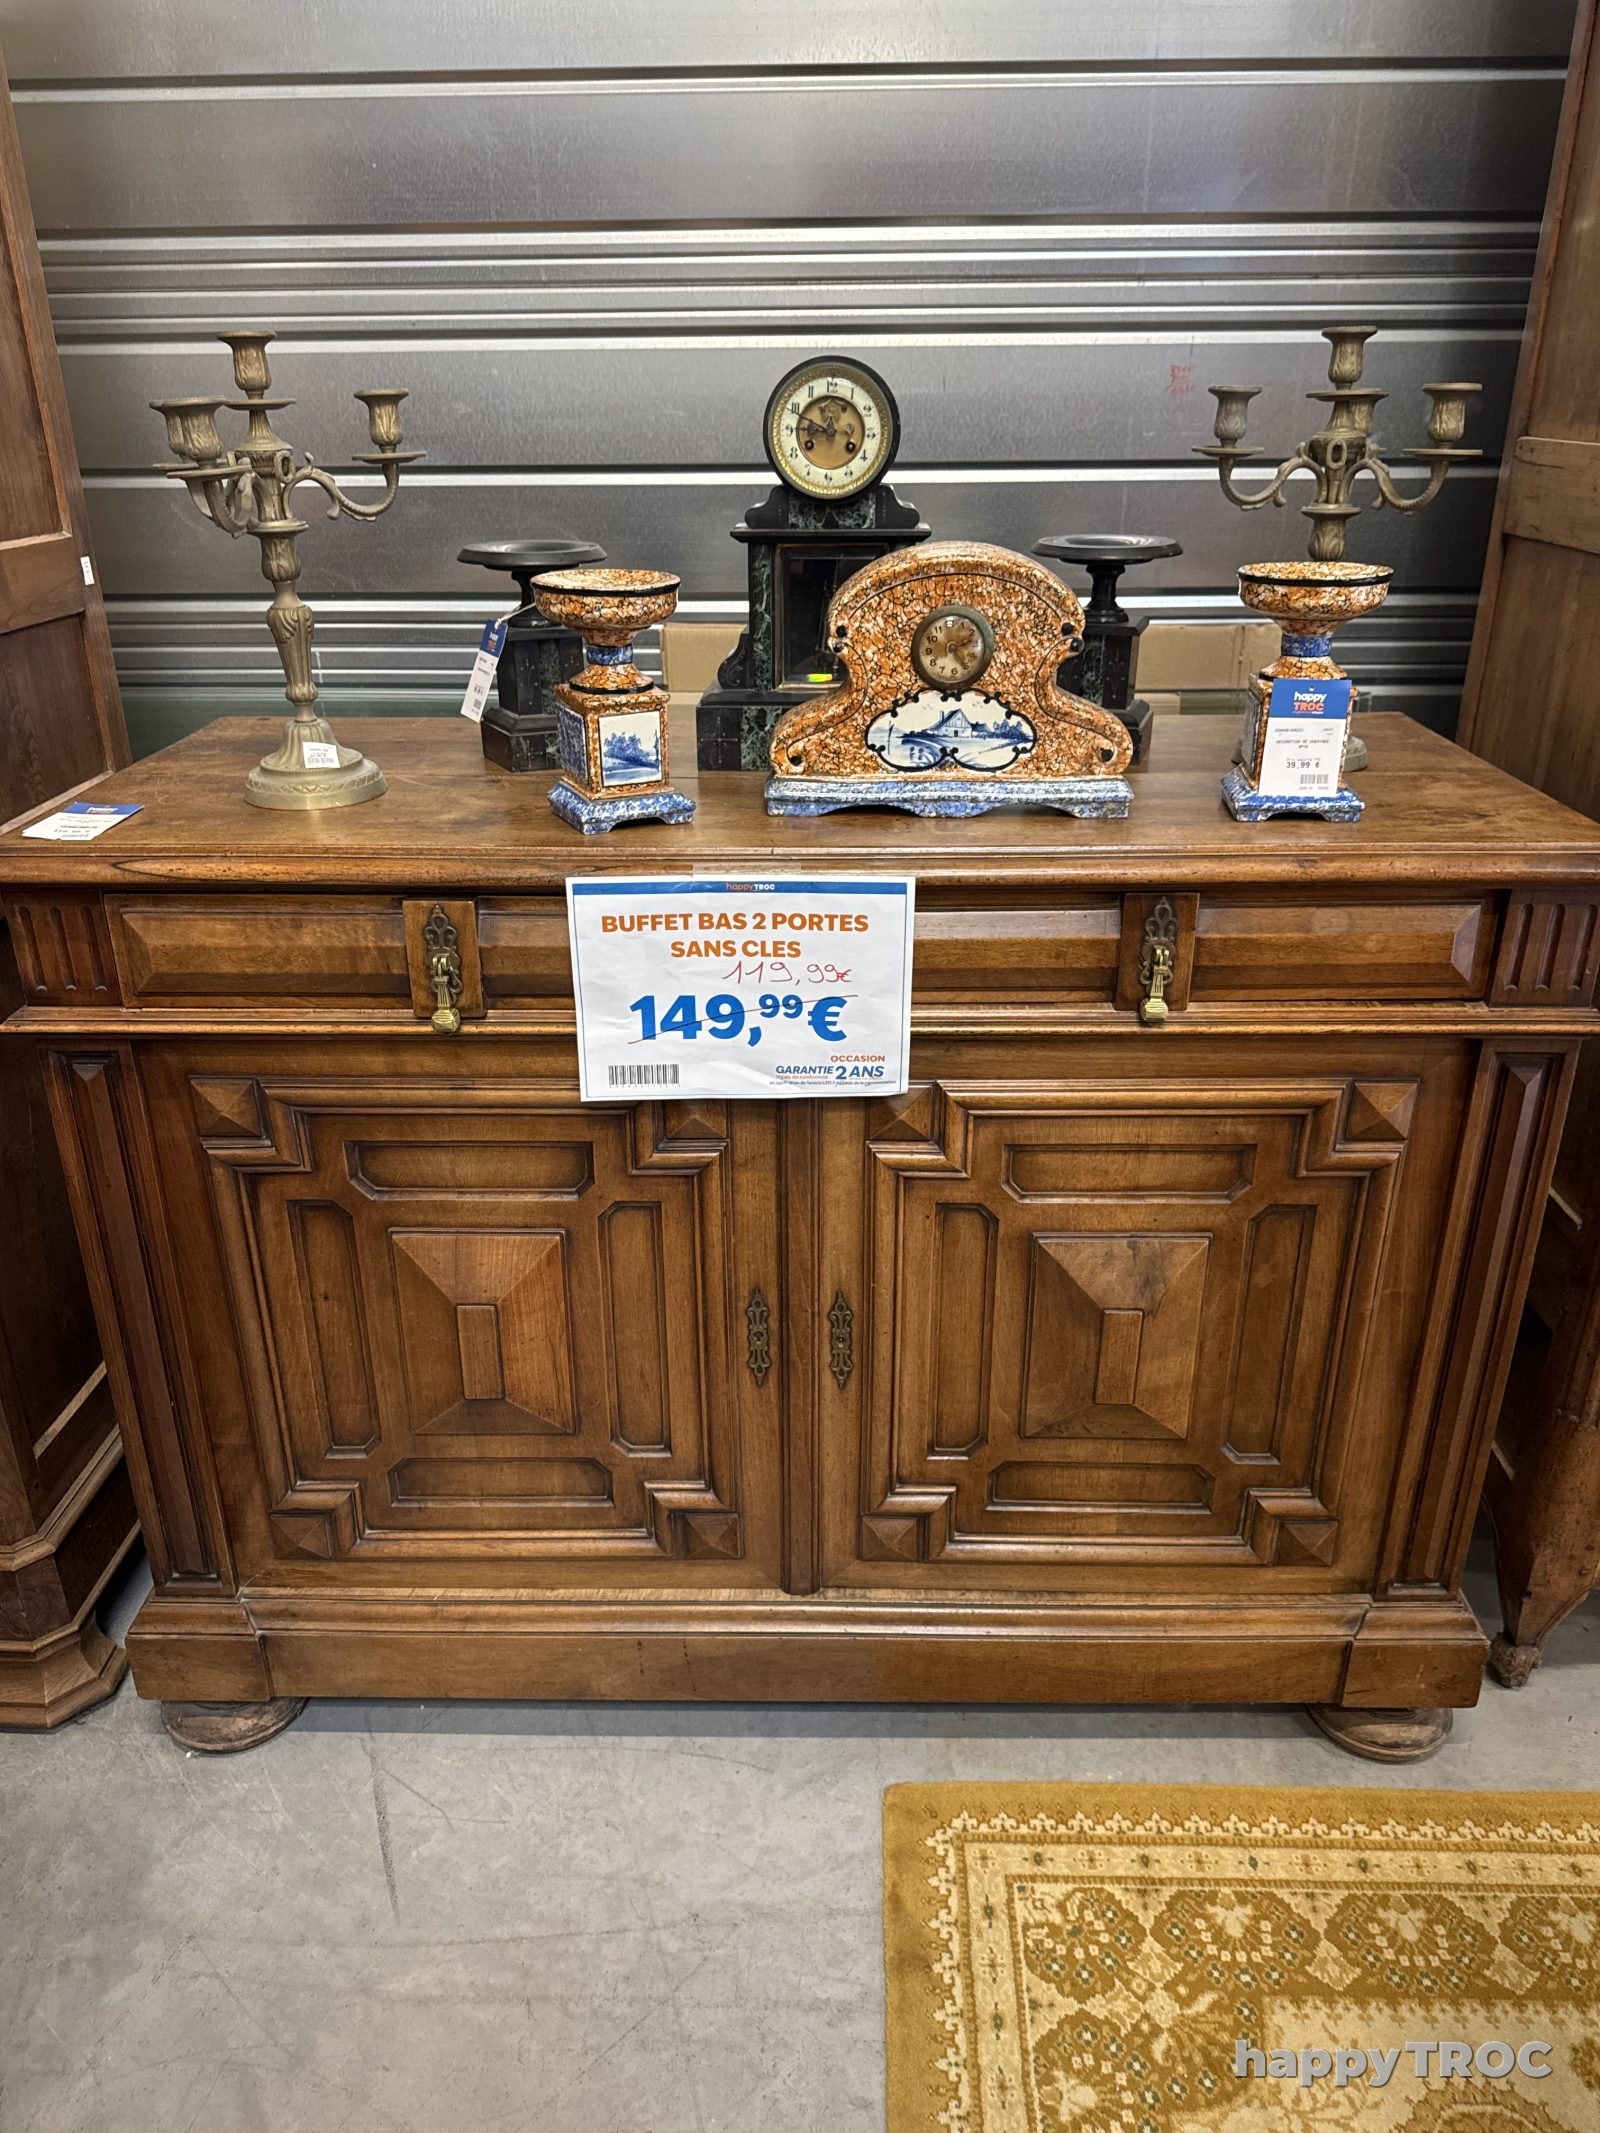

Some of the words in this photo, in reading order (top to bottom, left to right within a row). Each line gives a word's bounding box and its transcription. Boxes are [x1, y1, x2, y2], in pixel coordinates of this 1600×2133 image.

[785, 424, 794, 437] 9
[789, 446, 798, 459] 8
[860, 449, 868, 462] 4
[969, 629, 976, 637] 2
[925, 647, 932, 655] 9
[930, 659, 937, 667] 8
[939, 666, 945, 674] 7
[951, 667, 958, 675] 6
[1294, 692, 1327, 703] happy
[1293, 702, 1325, 712] TROC
[1286, 761, 1311, 770] 39,99
[601, 913, 693, 932] BUFFET
[699, 913, 747, 931] BAS
[752, 912, 766, 930] 2
[771, 913, 869, 932] PORTES
[670, 940, 737, 958] SANS
[741, 940, 801, 958] CLES
[830, 1055, 886, 1063] OCCASION
[775, 1065, 835, 1075] GARANTIE
[835, 1065, 847, 1080] 2
[849, 1065, 885, 1078] ANS
